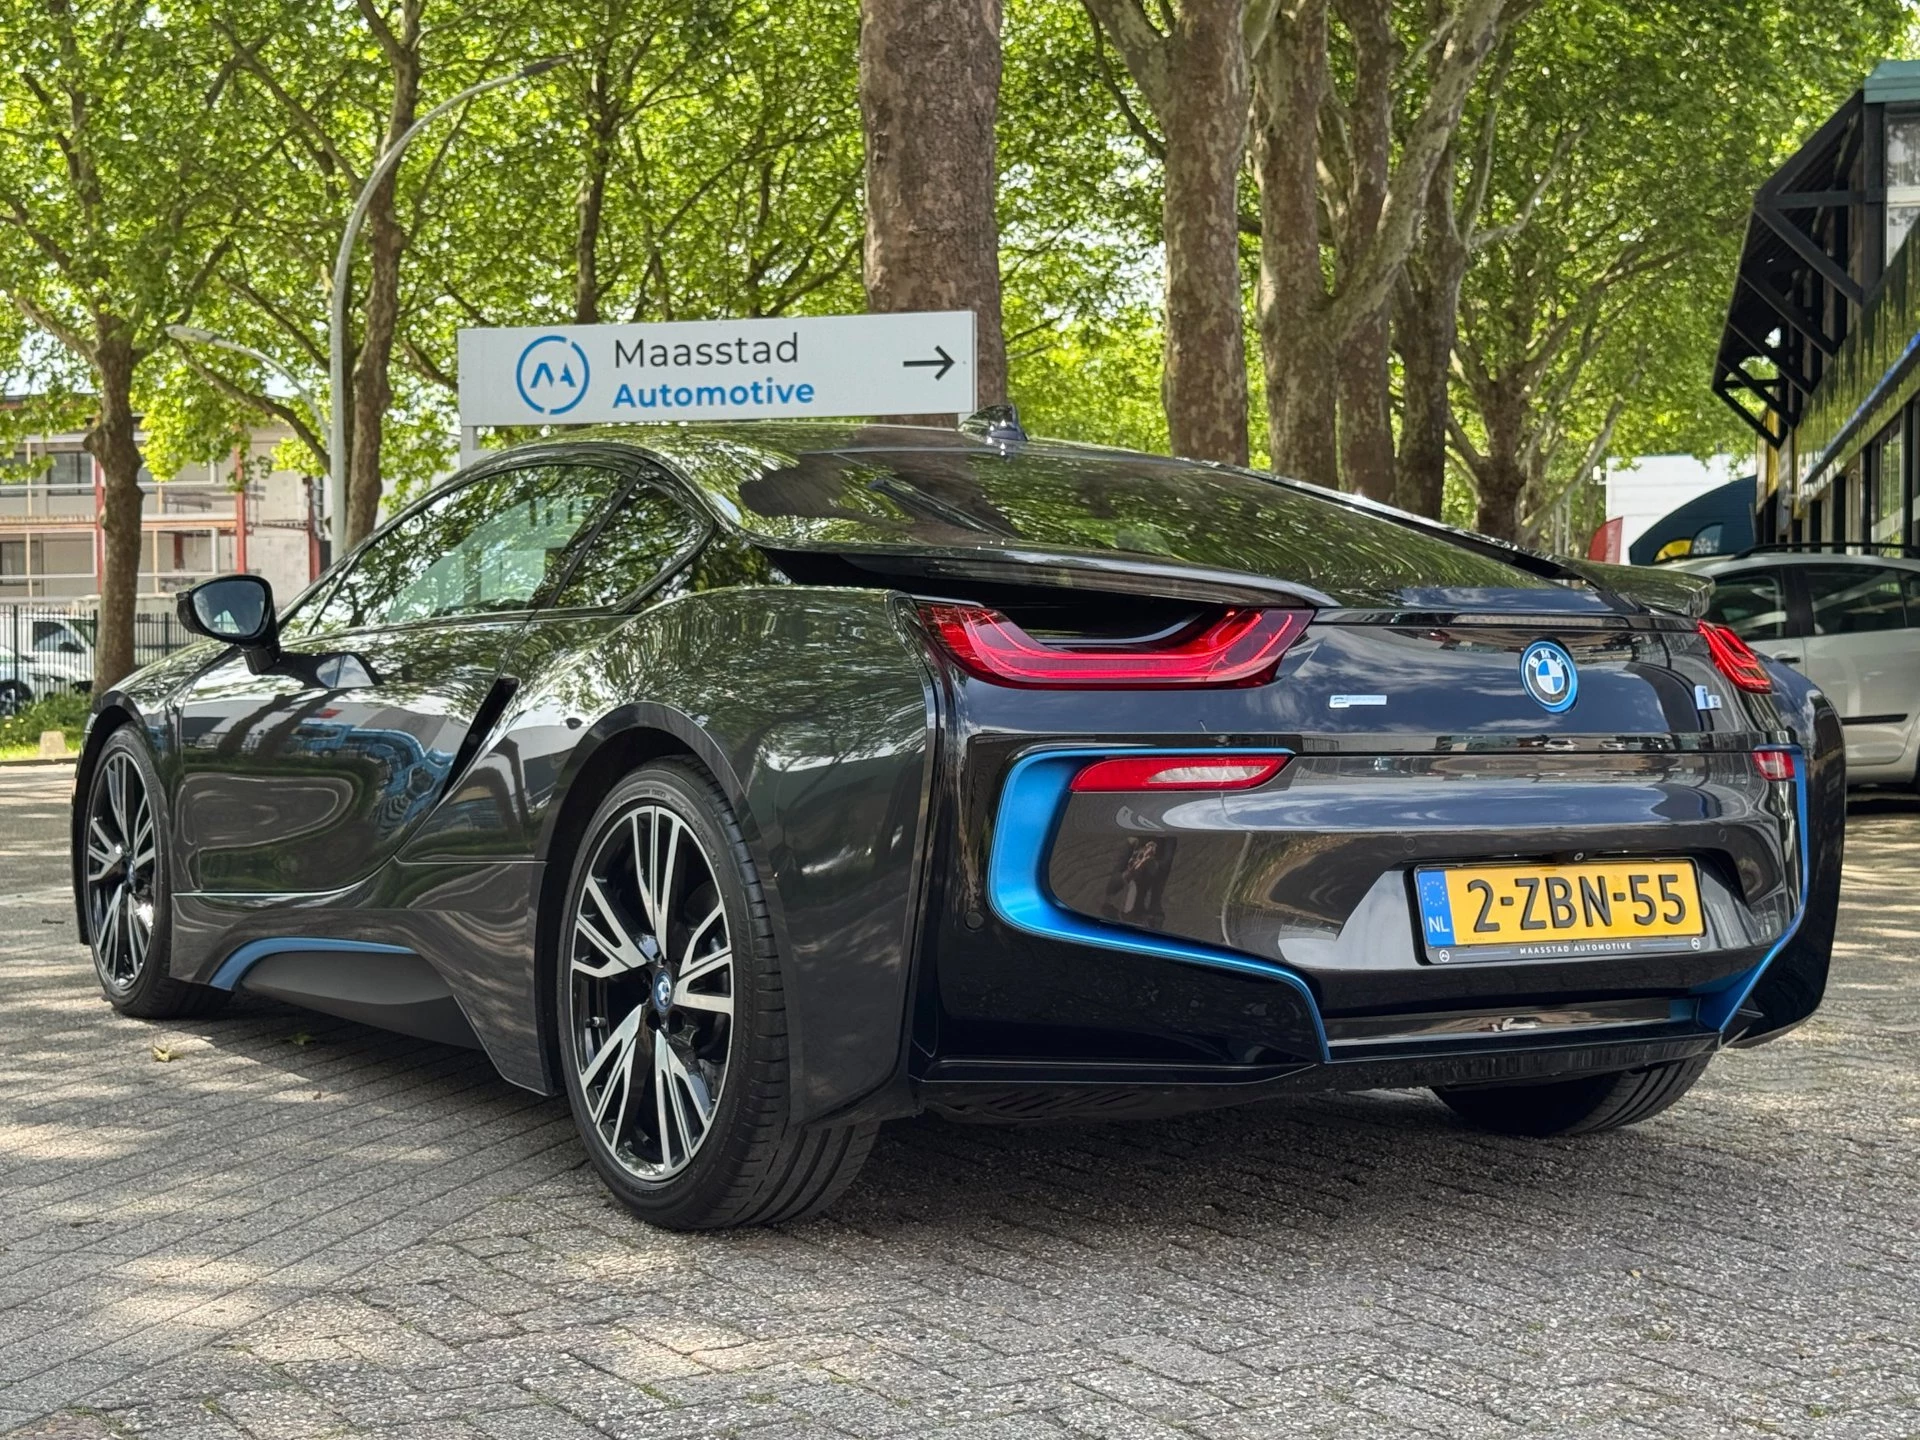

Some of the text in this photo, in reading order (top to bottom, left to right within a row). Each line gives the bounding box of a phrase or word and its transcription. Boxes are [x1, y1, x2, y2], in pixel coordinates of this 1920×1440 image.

[614, 332, 799, 368] Maasstad
[613, 377, 815, 409] Automotive
[1529, 649, 1564, 668] BMW
[1466, 874, 1687, 933] 2-ZBN-55
[1428, 915, 1450, 933] NL
[1520, 942, 1632, 955] MAASSTAD AUTOMOTIVE
